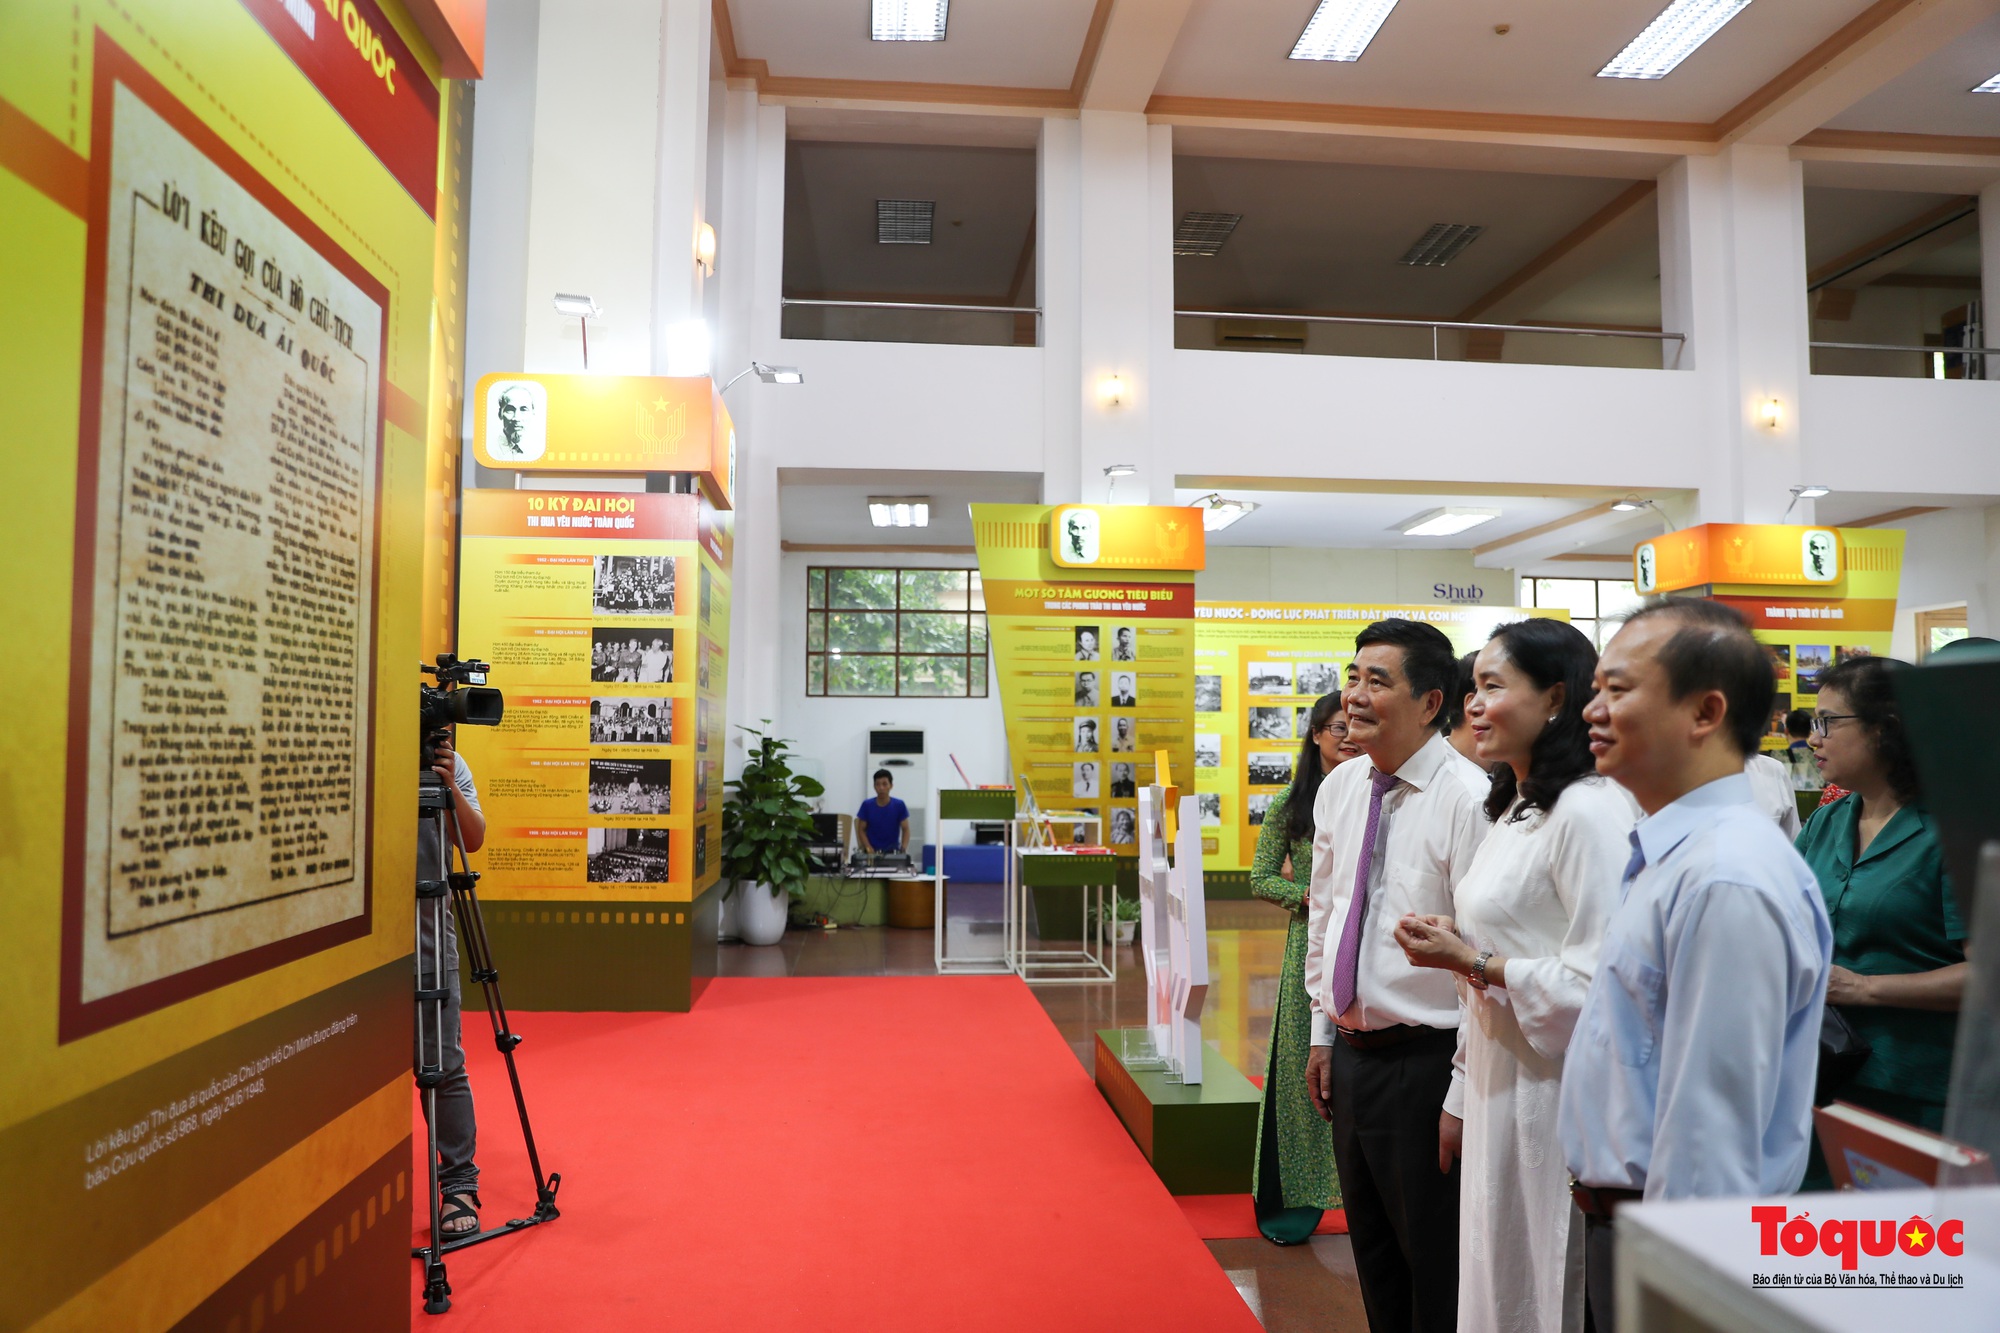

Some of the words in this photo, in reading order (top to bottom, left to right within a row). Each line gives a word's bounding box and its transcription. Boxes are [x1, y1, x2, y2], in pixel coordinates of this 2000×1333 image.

[190, 272, 226, 311] THI
[528, 498, 544, 510] 10
[548, 496, 570, 511] KỲ
[572, 498, 601, 513] ĐẠI
[605, 497, 635, 514] HỘI
[1434, 583, 1483, 600] S.hub
